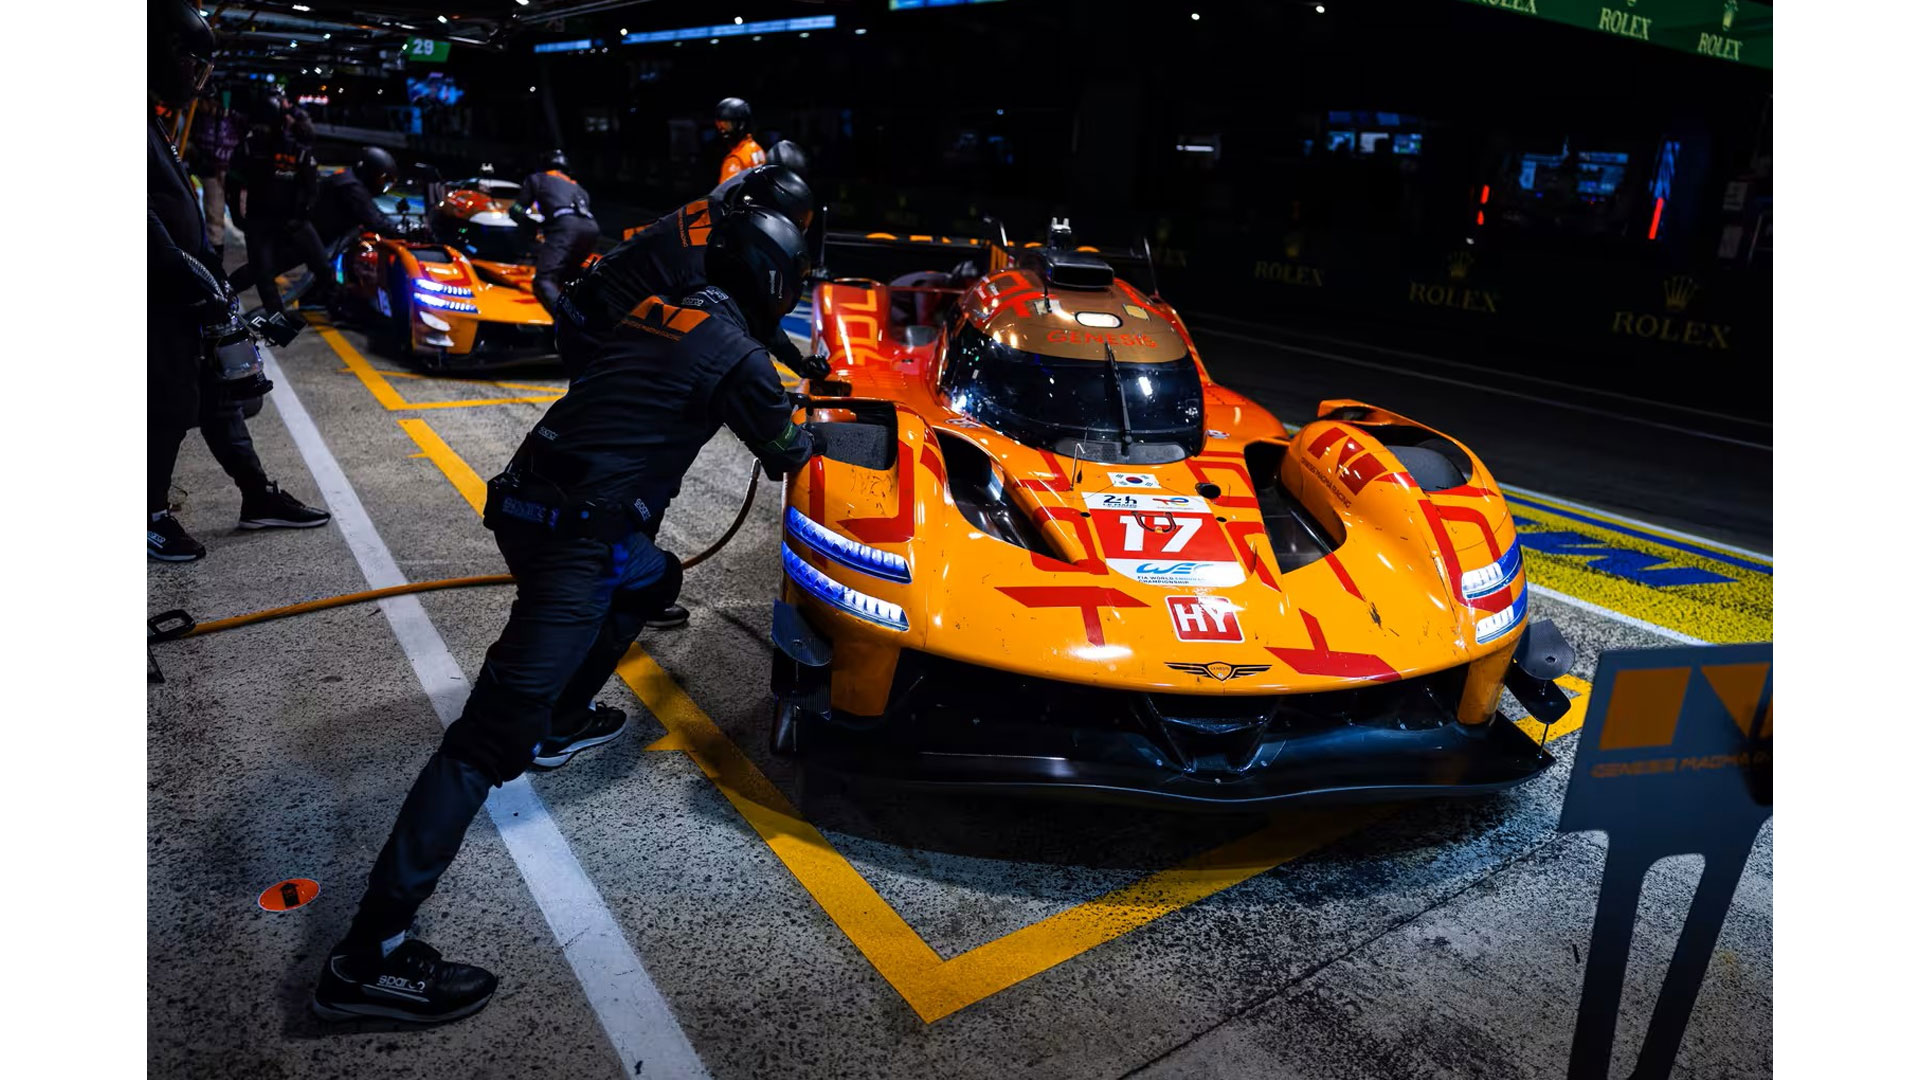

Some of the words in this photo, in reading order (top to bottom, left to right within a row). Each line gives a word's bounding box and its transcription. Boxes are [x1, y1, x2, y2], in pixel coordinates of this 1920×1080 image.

[1599, 7, 1652, 40] ROLEX
[412, 38, 435, 56] 29
[1697, 32, 1743, 61] ROLEX
[1254, 259, 1325, 287] ROLEX
[1408, 281, 1497, 313] ROLEX
[1046, 330, 1157, 348] GENESIS
[1610, 309, 1733, 350] ROLEX
[1119, 515, 1203, 552] 17
[1173, 603, 1231, 633] HY
